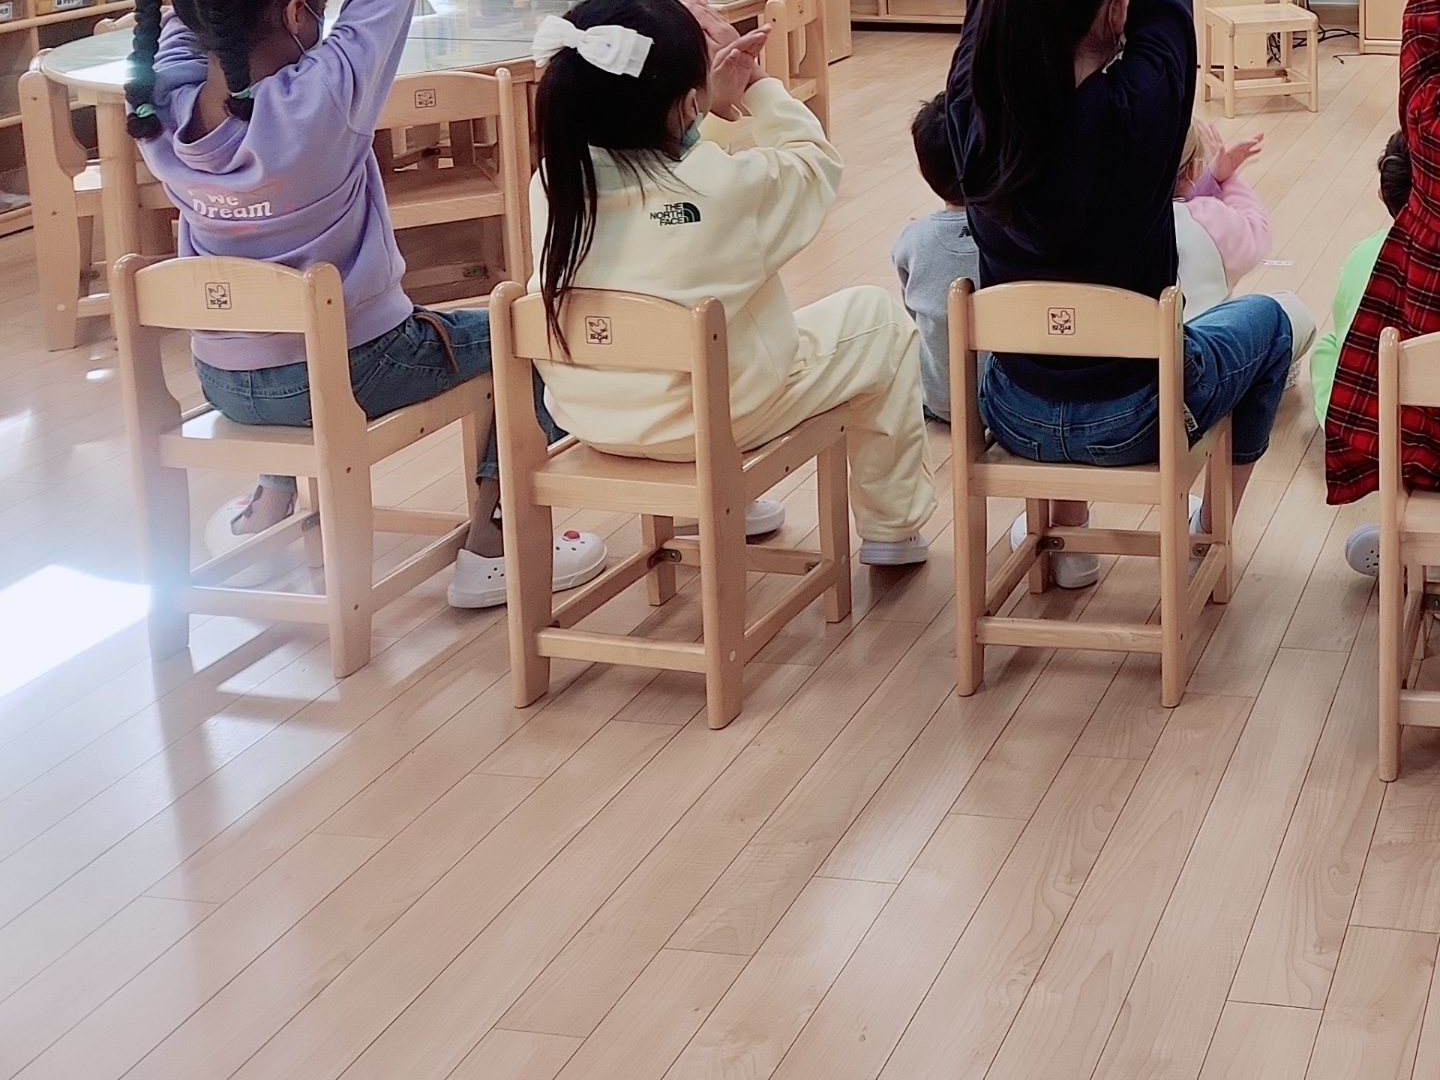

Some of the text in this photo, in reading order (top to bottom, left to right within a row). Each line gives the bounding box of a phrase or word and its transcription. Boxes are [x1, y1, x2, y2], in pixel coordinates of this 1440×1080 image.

[192, 198, 273, 219] Dream
[663, 202, 682, 211] THE
[650, 210, 683, 220] NORTH
[659, 217, 684, 227] FACE
